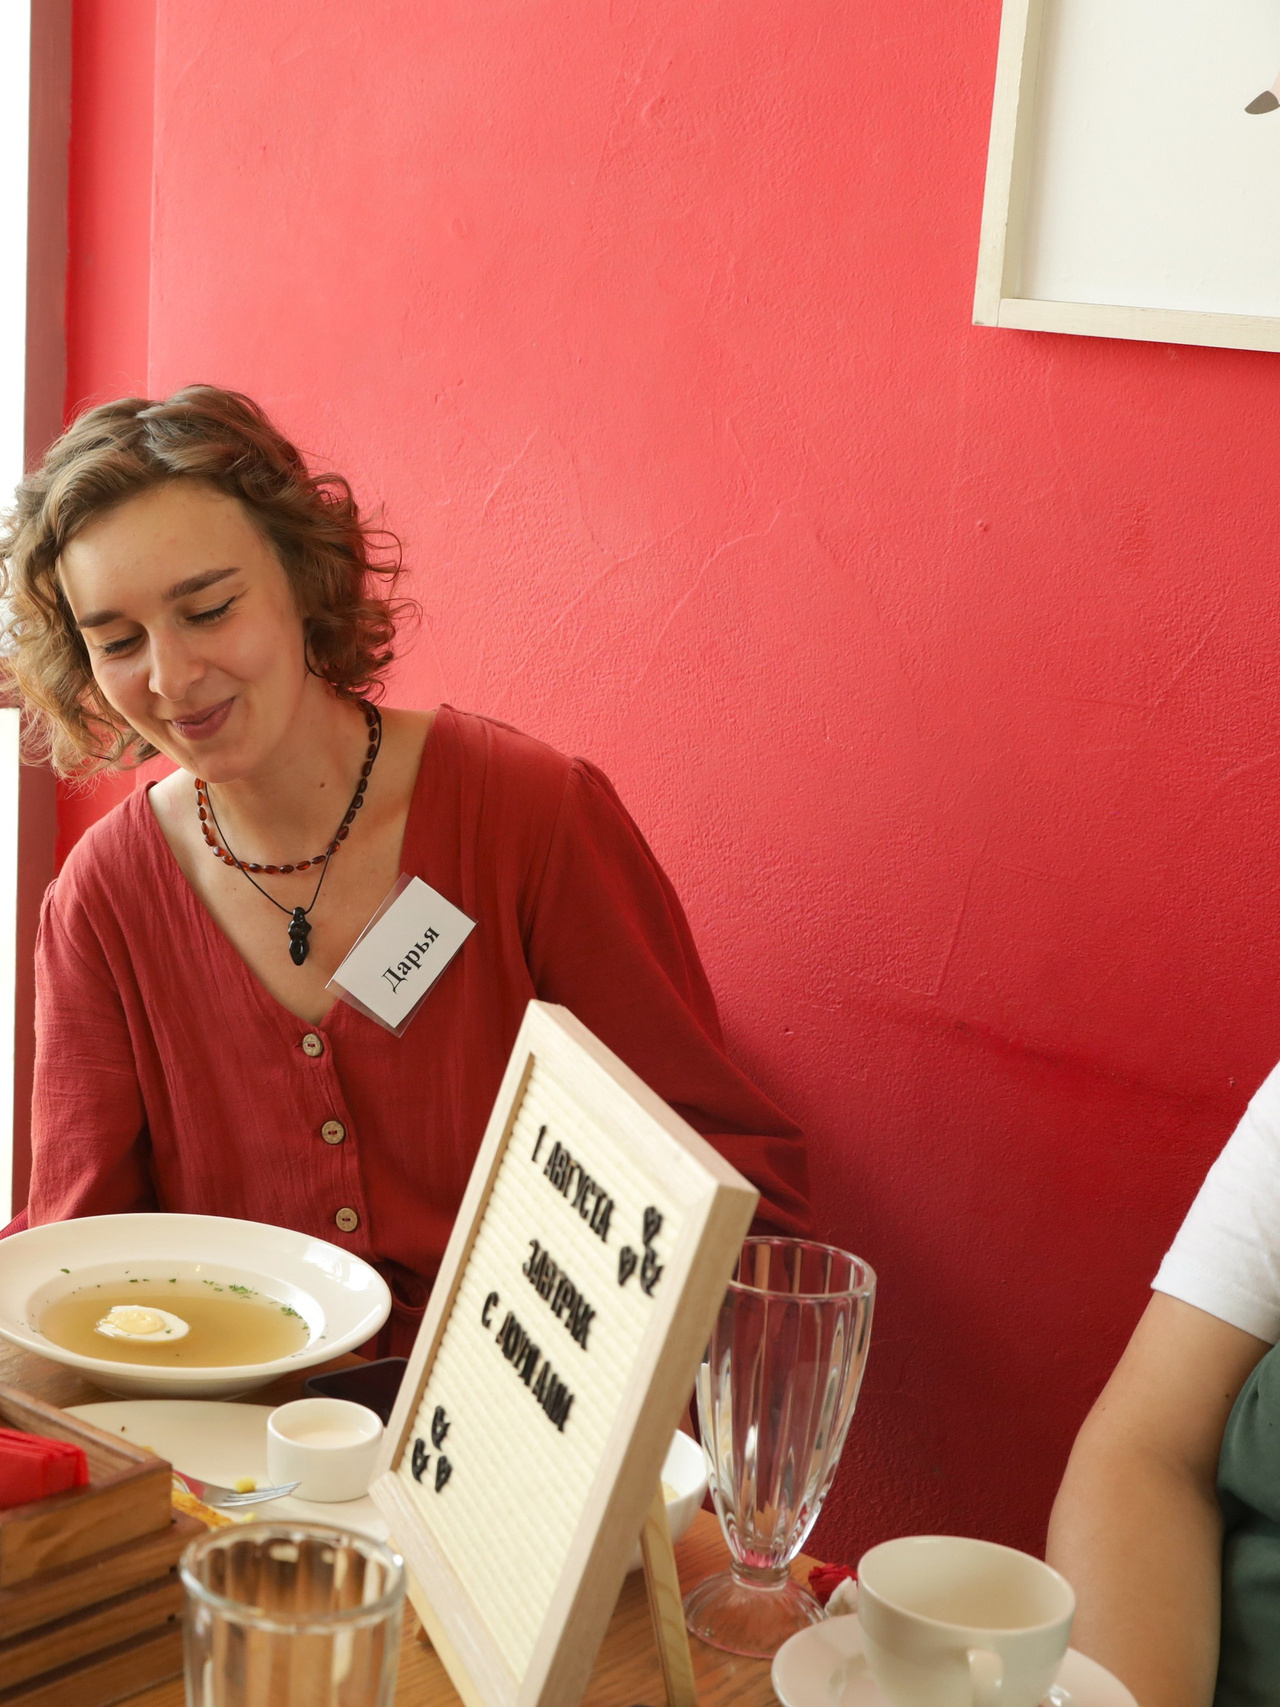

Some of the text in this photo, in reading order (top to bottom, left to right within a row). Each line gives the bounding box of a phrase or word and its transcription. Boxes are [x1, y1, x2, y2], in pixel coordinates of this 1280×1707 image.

[381, 926, 440, 994] Дарья
[531, 1125, 615, 1243] 1 АВГУСТА
[481, 1291, 500, 1329] С
[522, 1239, 596, 1351] ЗАВТРАК
